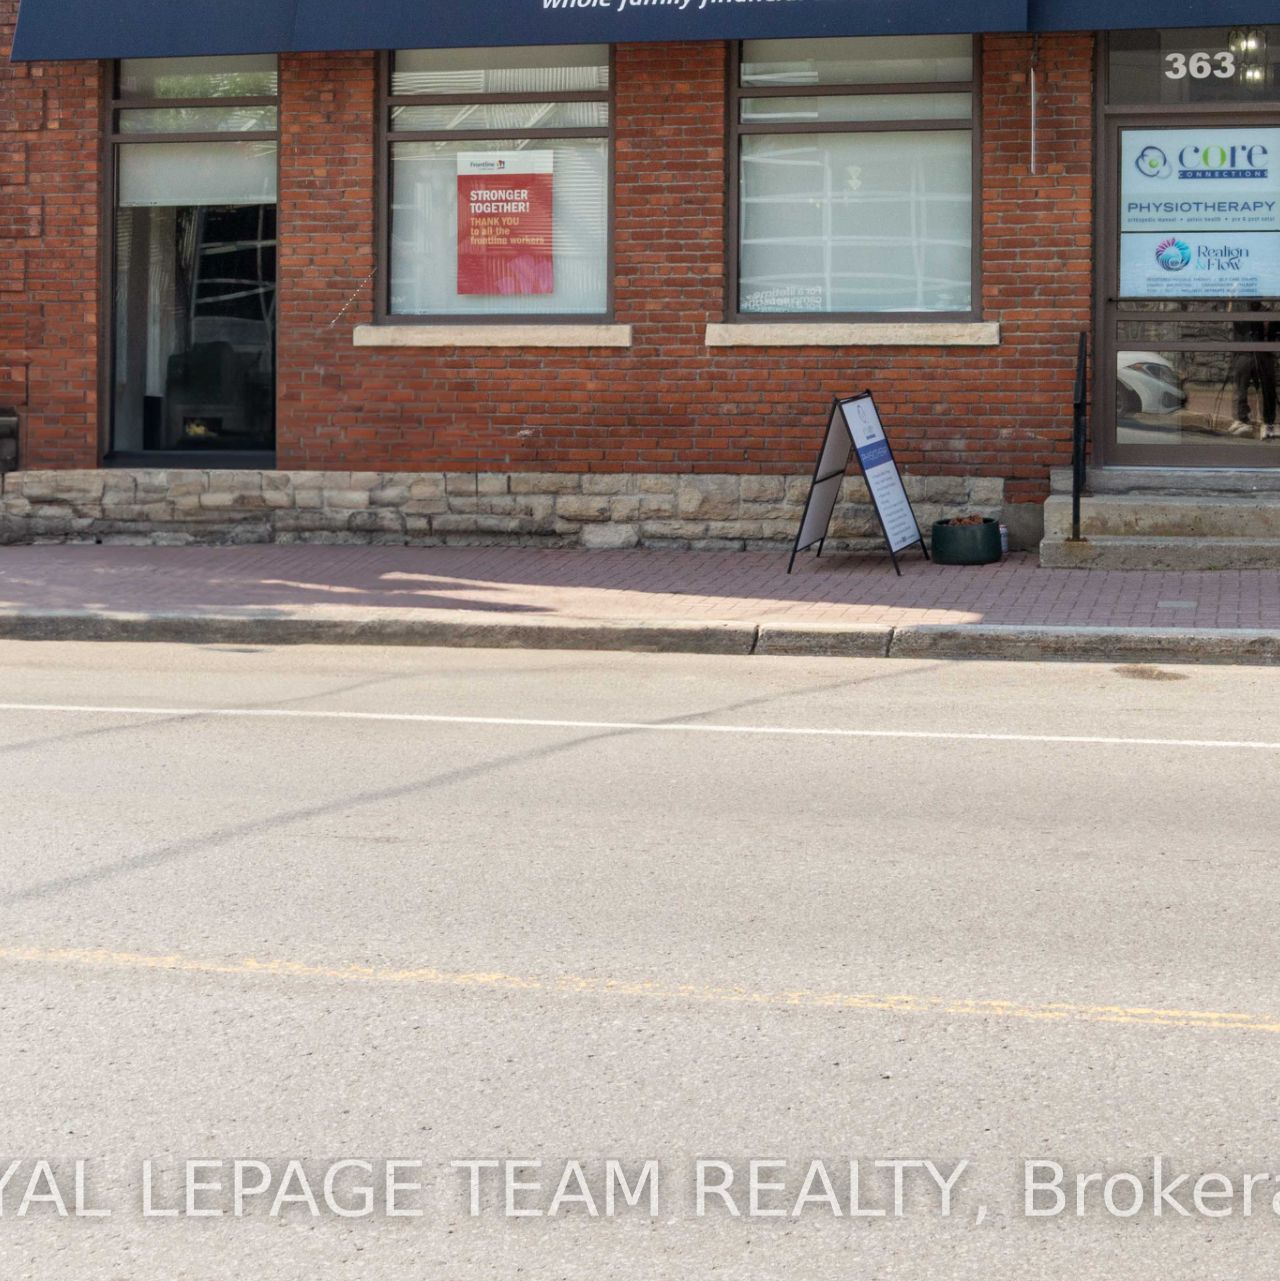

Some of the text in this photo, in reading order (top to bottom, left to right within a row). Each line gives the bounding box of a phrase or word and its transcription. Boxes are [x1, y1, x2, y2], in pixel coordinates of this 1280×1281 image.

[1165, 51, 1235, 79] 363
[1178, 144, 1269, 169] core
[1178, 170, 1268, 178] CONNECTIONS
[470, 189, 528, 201] STRONGER
[470, 202, 530, 214] TOGETHER!
[1127, 201, 1276, 213] PHYSIOTHERAPY
[470, 217, 520, 226] THANK YOU
[482, 227, 492, 235] all
[496, 227, 510, 235] the
[510, 236, 545, 245] workers
[1197, 245, 1249, 260] Realign
